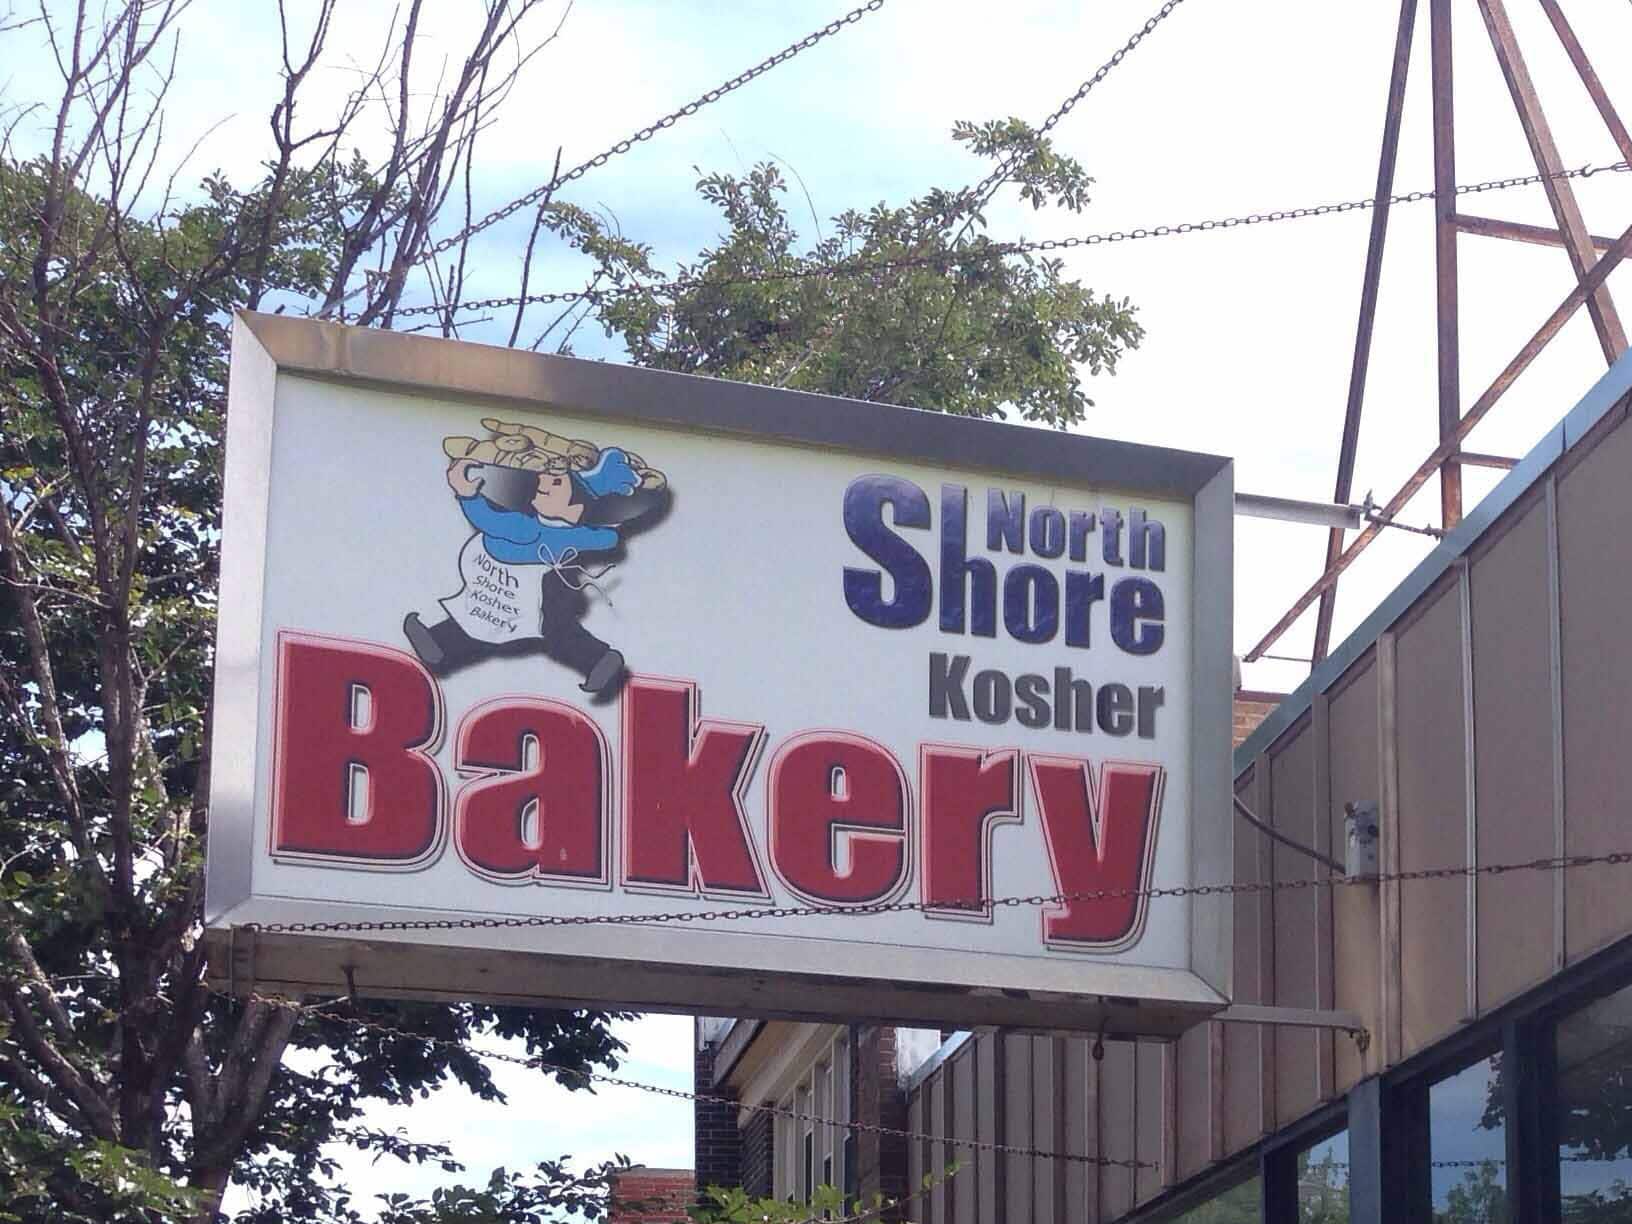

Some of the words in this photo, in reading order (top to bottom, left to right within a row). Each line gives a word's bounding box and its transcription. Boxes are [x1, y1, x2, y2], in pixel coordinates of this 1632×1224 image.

[986, 487, 1166, 572] North
[472, 575, 518, 600] Shore
[474, 553, 519, 588] North
[843, 473, 1166, 656] Shore
[469, 606, 518, 633] Bakery
[470, 590, 521, 615] Kosher
[928, 652, 1165, 739] Kosher
[269, 628, 1167, 953] Bakery
